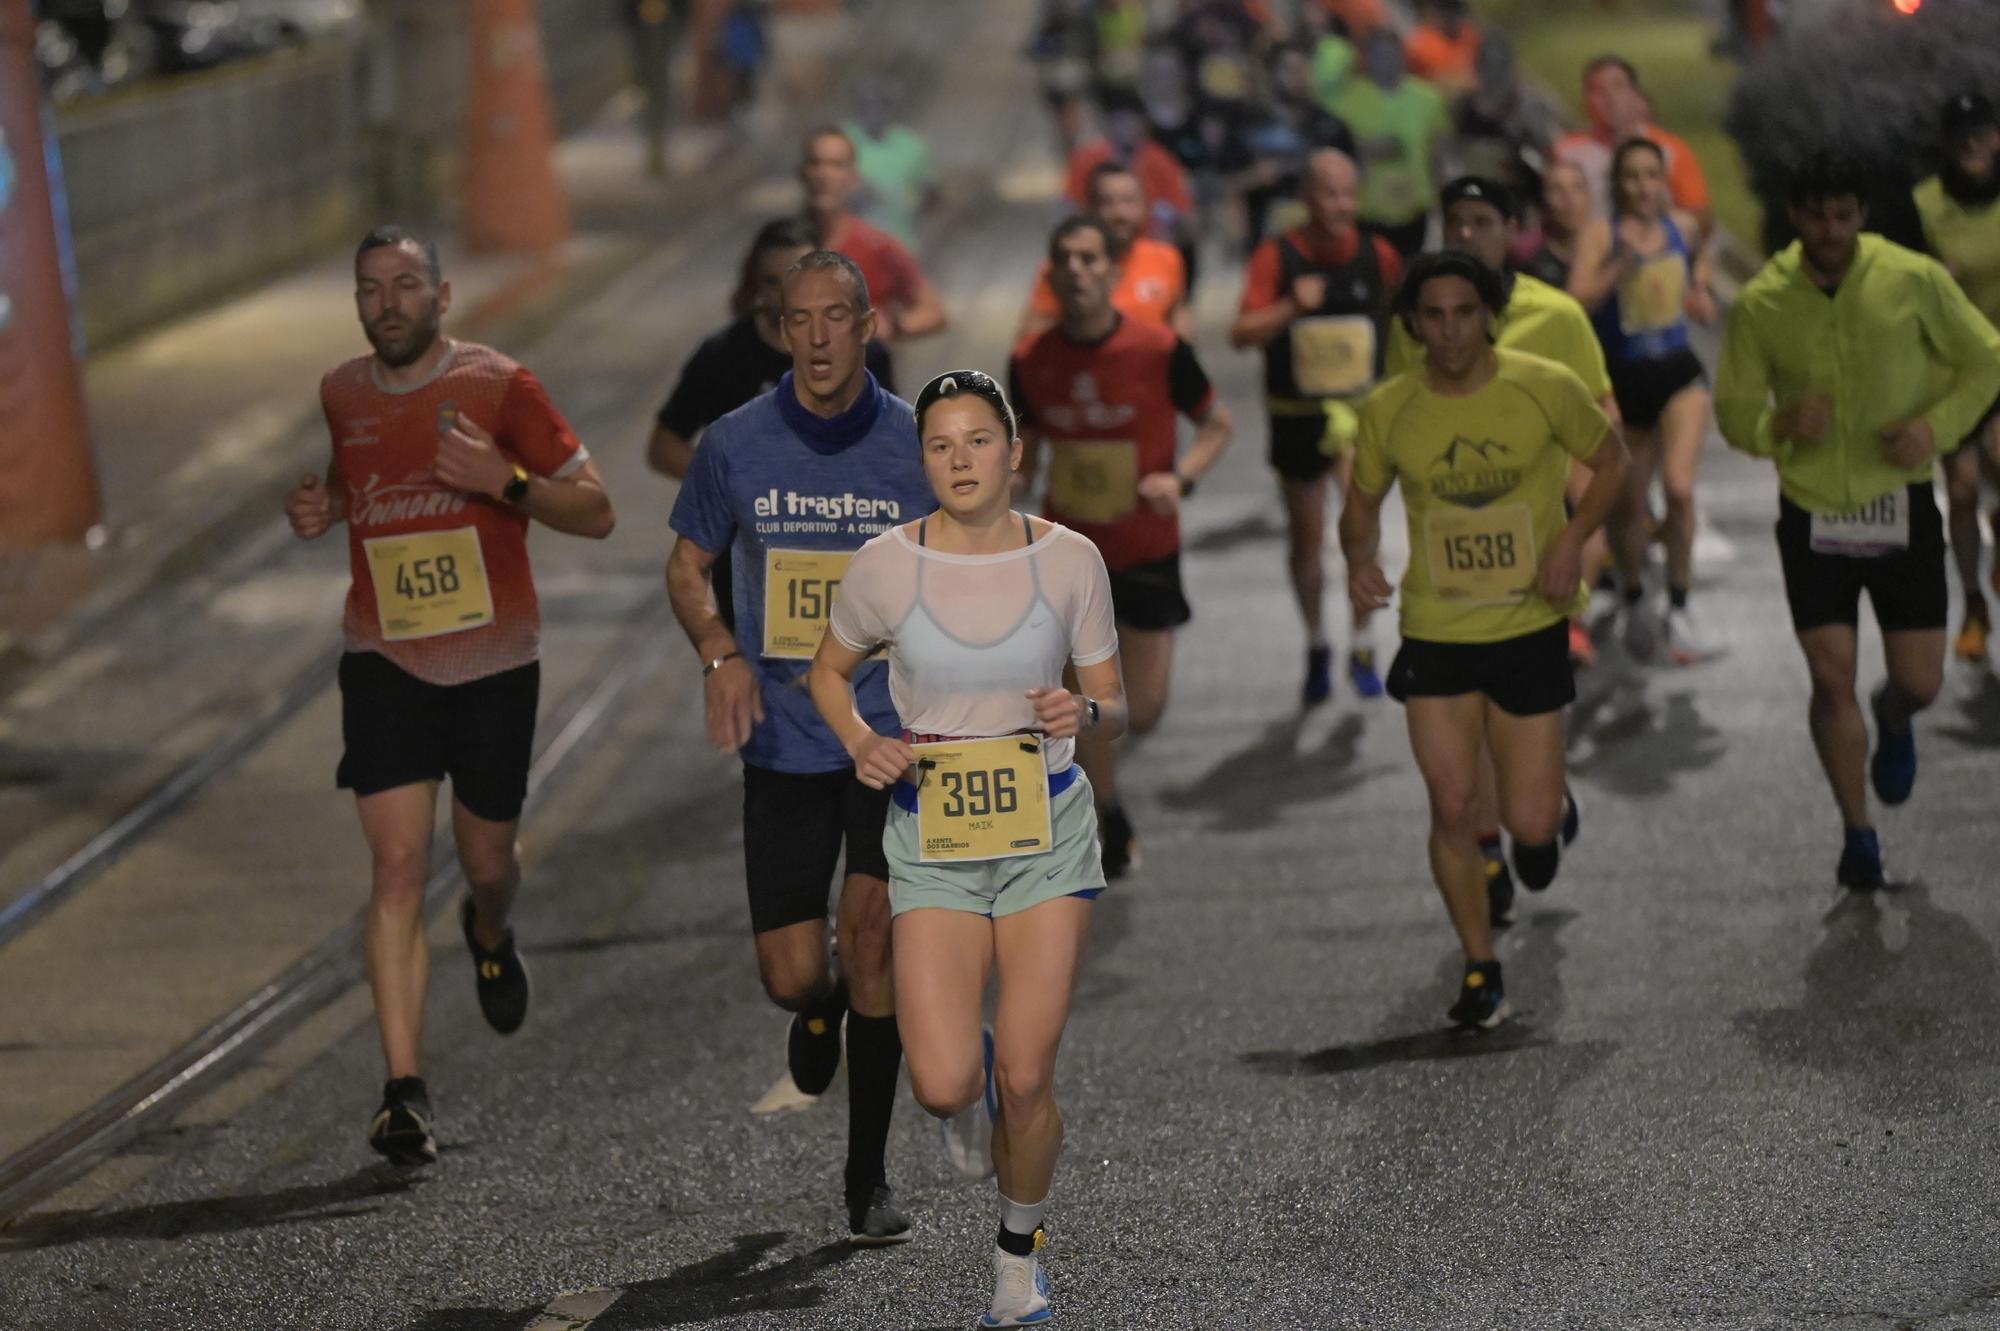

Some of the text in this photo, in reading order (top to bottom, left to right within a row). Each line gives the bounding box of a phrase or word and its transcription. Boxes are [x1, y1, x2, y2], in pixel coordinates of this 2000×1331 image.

[754, 488, 900, 519] el trastero
[755, 521, 780, 533] CLUB
[783, 521, 837, 533] DEPORTIVO
[847, 522, 855, 533] A
[1444, 531, 1516, 571] 1538
[395, 554, 460, 600] 458
[941, 767, 1018, 817] 396
